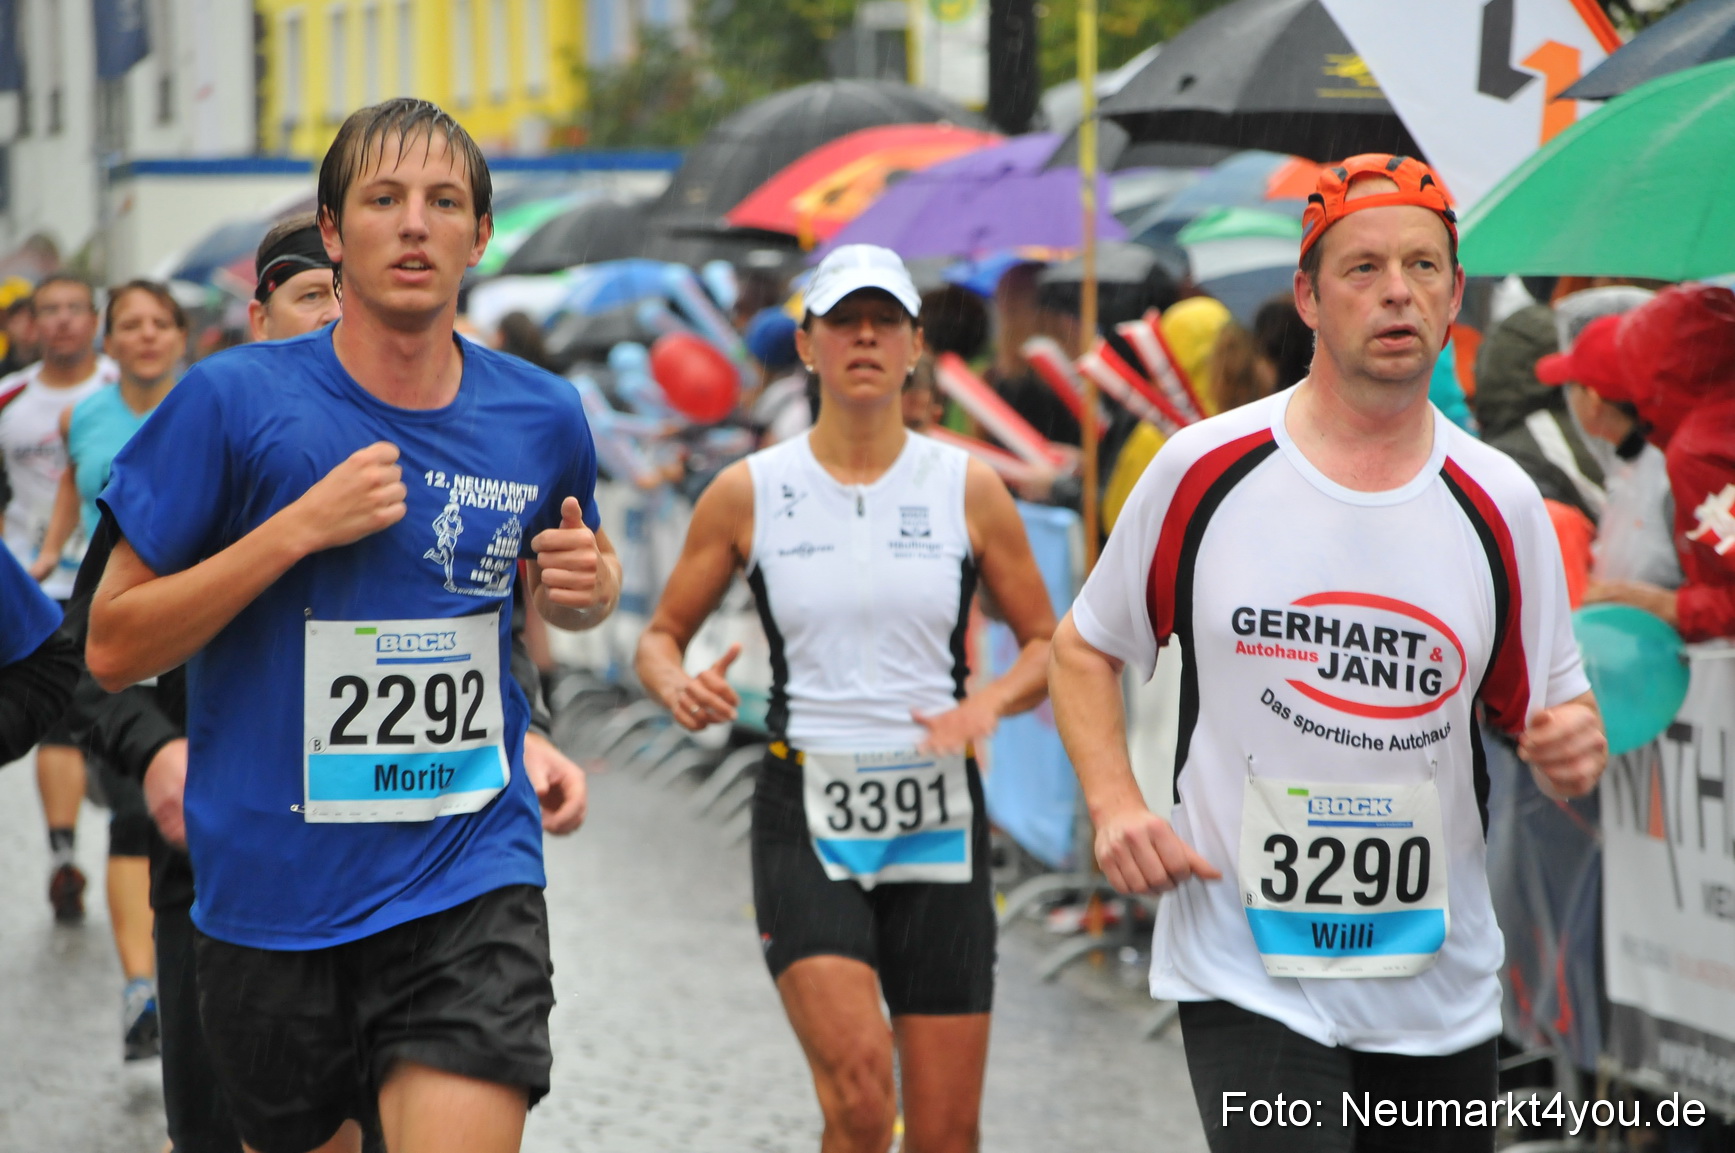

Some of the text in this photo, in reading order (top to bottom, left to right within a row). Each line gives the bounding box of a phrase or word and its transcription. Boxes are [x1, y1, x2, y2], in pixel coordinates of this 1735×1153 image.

[424, 469, 539, 502] 12. NEUMARKTER
[448, 487, 526, 514] STADTLAUF
[376, 631, 457, 653] BOCK
[1231, 606, 1443, 663] GERHART &
[1235, 640, 1319, 664] Autohaus
[1317, 651, 1443, 697] JÄNIG
[329, 669, 488, 745] 2292
[1260, 687, 1452, 752] Das sportliche Autohaus
[313, 740, 321, 752] B
[374, 763, 455, 792] Moritz
[825, 773, 949, 833] 3391
[1308, 796, 1393, 816] BOCK
[1260, 833, 1431, 907] 3290
[1311, 922, 1374, 950] Willi
